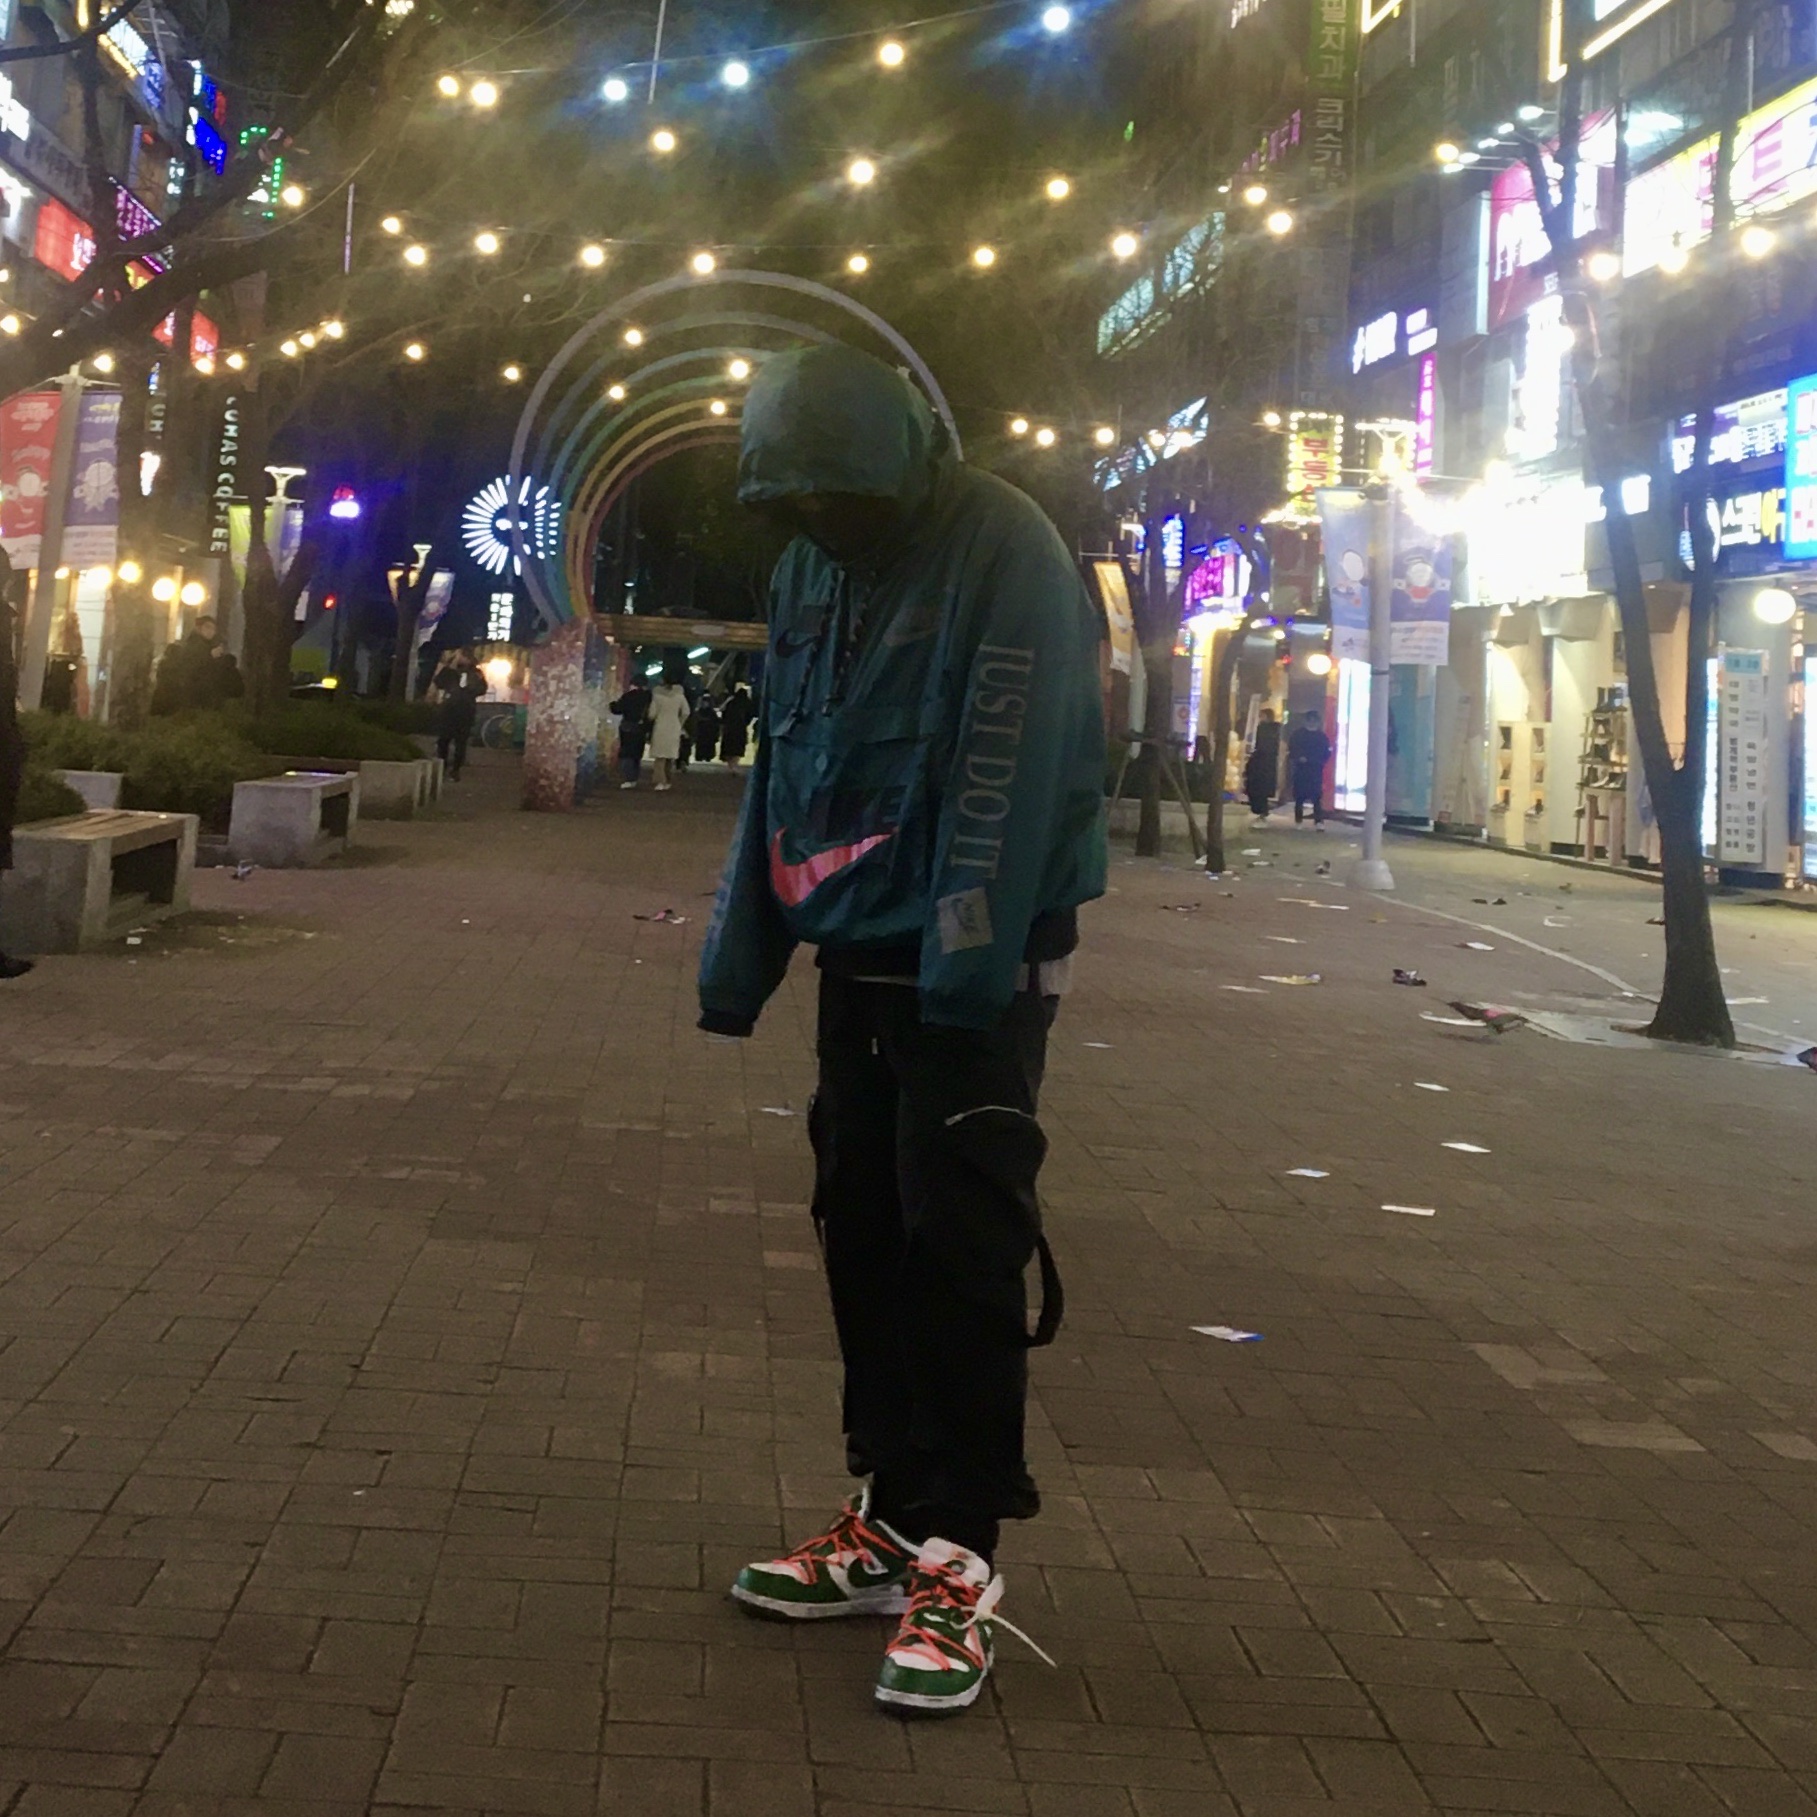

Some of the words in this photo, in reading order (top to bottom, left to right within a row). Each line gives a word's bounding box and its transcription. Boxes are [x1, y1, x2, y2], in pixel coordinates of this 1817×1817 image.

[210, 472, 235, 553] COFFEE
[970, 643, 1036, 746] JUST
[957, 753, 1018, 822] DO
[948, 831, 1004, 880] IT
